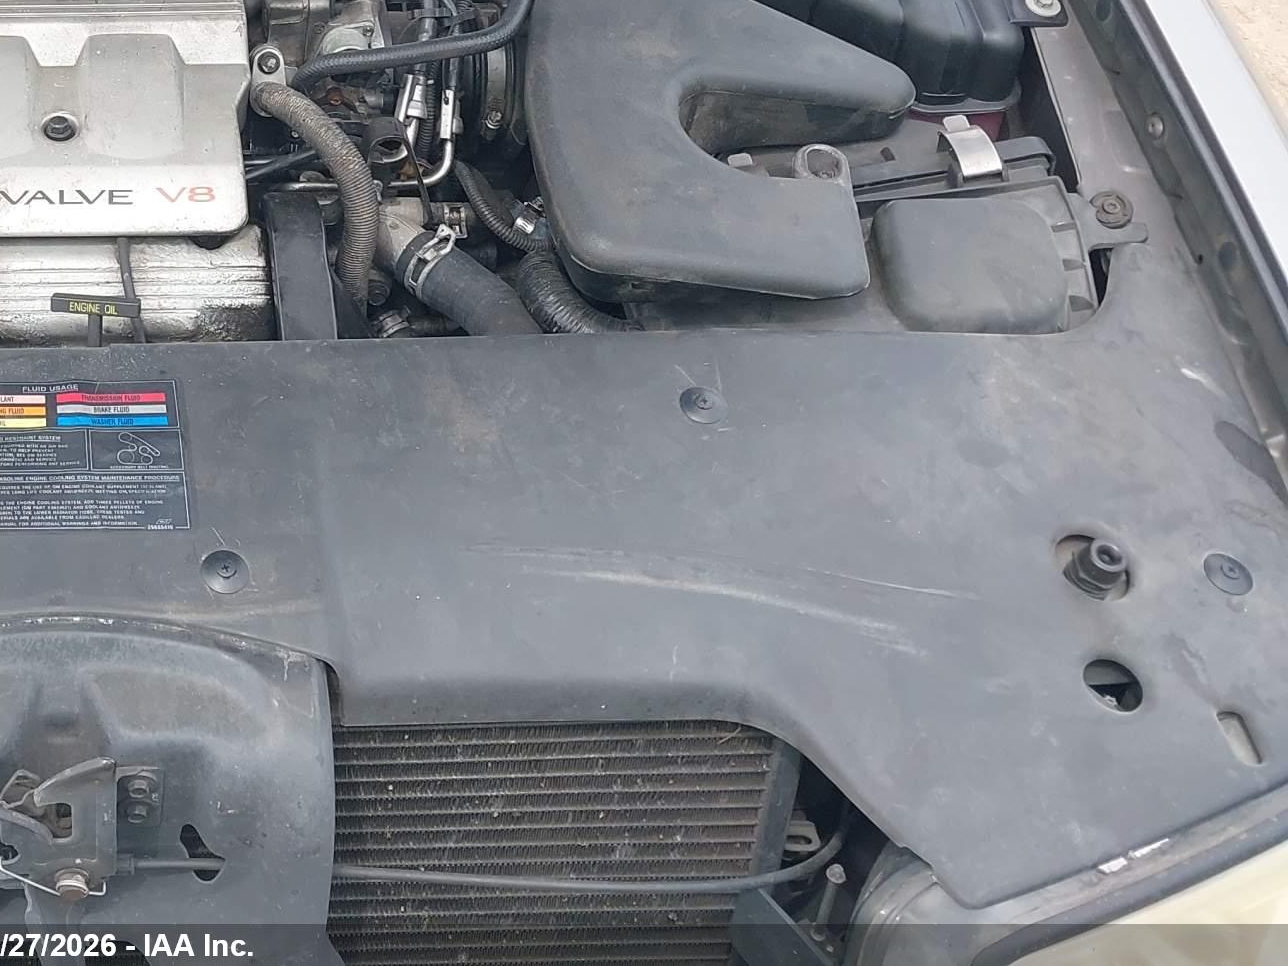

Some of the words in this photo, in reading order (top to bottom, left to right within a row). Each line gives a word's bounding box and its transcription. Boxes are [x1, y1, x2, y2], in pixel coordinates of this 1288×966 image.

[156, 187, 216, 204] V8
[69, 301, 100, 313] ENGINE
[104, 304, 118, 315] OIL
[49, 384, 79, 392] USAGE
